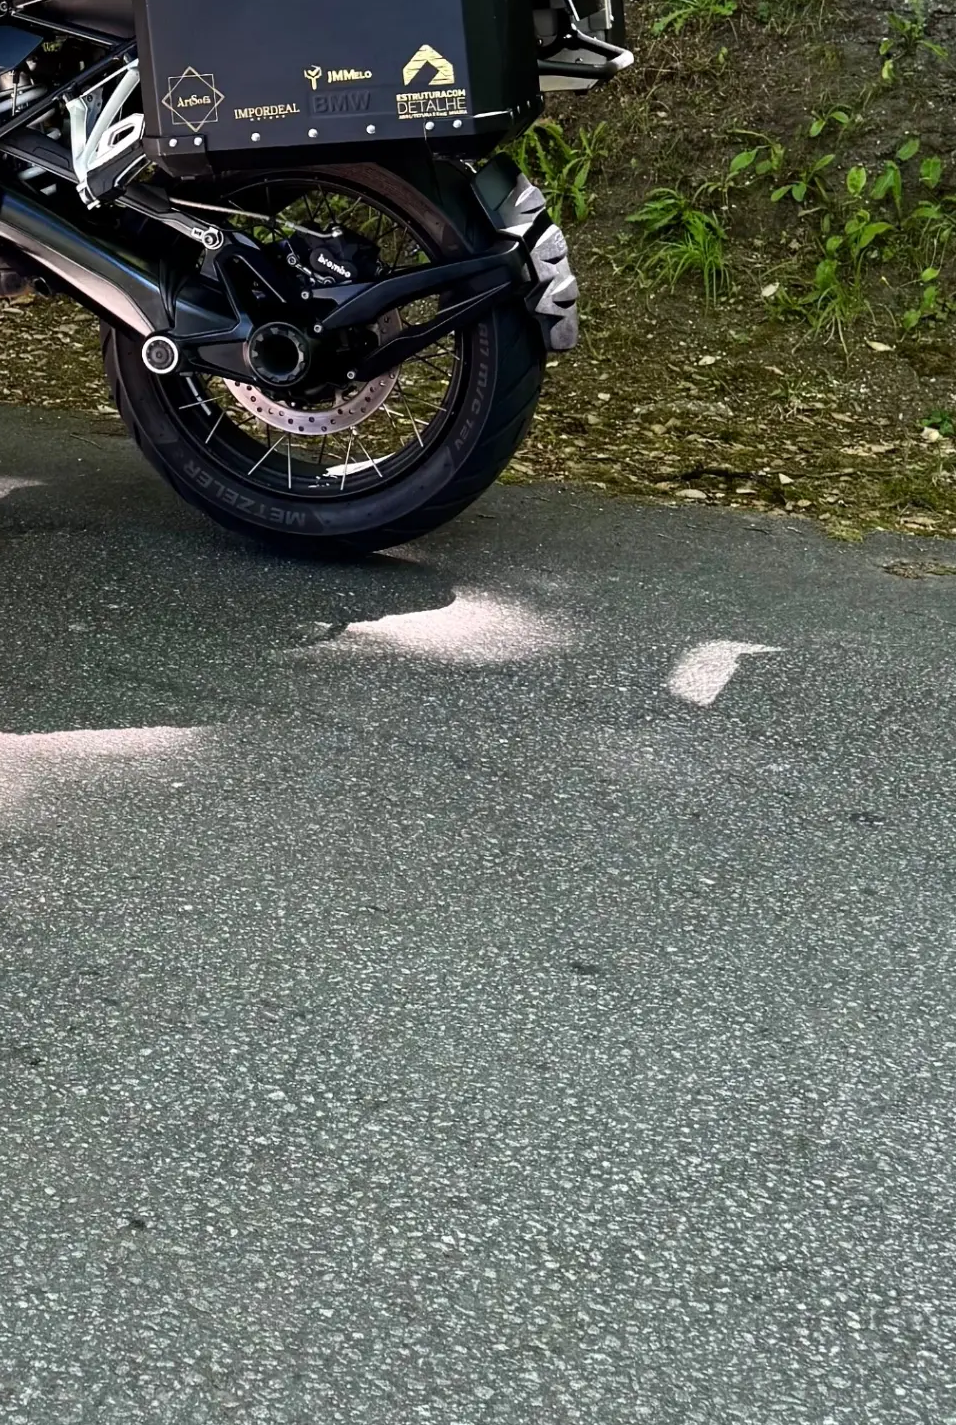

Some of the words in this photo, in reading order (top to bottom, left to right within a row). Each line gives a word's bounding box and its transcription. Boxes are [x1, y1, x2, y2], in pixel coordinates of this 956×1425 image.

[233, 102, 301, 120] IMPORDEAL
[312, 90, 371, 115] BMW
[397, 96, 467, 115] DETALHE
[317, 253, 351, 278] brembo
[182, 459, 306, 525] METZELER
